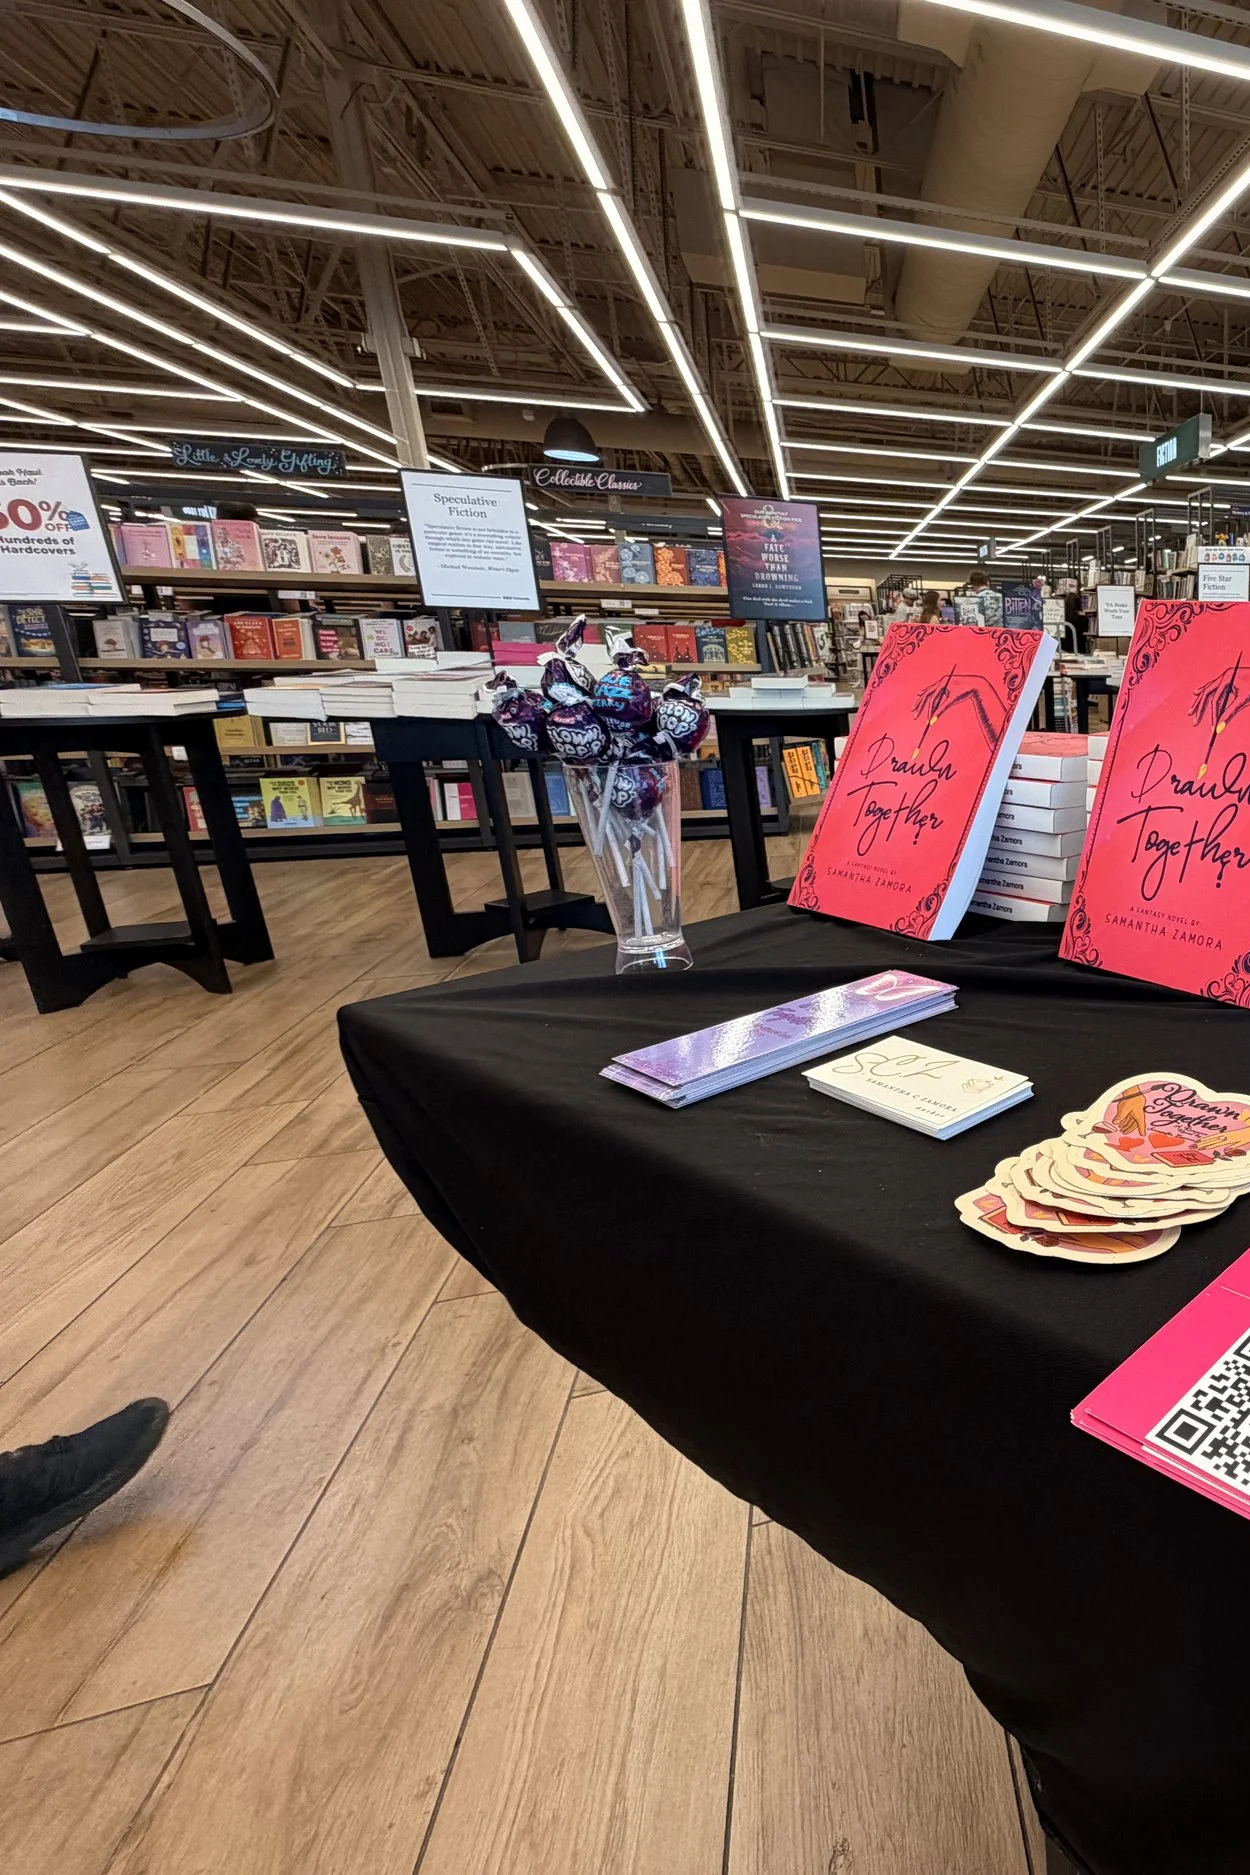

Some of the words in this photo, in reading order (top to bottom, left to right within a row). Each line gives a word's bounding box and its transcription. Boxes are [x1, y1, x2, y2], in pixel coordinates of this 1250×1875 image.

[175, 444, 219, 466] Little
[231, 447, 277, 470] Lovely
[278, 450, 337, 475] Gifting
[533, 468, 595, 487] Collectible
[595, 472, 643, 490] Classics
[433, 493, 498, 507] Speculative
[448, 506, 488, 519] Fiction
[62, 536, 75, 545] of
[1, 546, 76, 555] Hardcovers
[764, 543, 784, 553] FATE
[761, 553, 790, 563] WORSE
[764, 562, 788, 573] THAN
[754, 572, 800, 583] DROWNING
[1202, 574, 1217, 583] Five
[1218, 574, 1233, 583] Star
[1202, 582, 1226, 591] Fiction
[1005, 597, 1032, 615] BITTEN
[860, 733, 958, 779] Drawn
[847, 779, 945, 857] Together
[1005, 859, 1028, 869] Zamora
[827, 867, 871, 884] SAMANTHA
[875, 877, 912, 893] ZAMORA
[1002, 880, 1024, 891] Zamora
[1136, 907, 1165, 919] FANTASY
[1167, 915, 1188, 925] NOVEL
[1105, 913, 1166, 937] SAMANTHA
[1172, 929, 1223, 951] ZAMORA
[866, 1077, 910, 1097] SAMANTHA
[920, 1096, 958, 1113] ZAMORA
[1160, 1082, 1241, 1121] Drawn
[1144, 1096, 1228, 1134] Together
